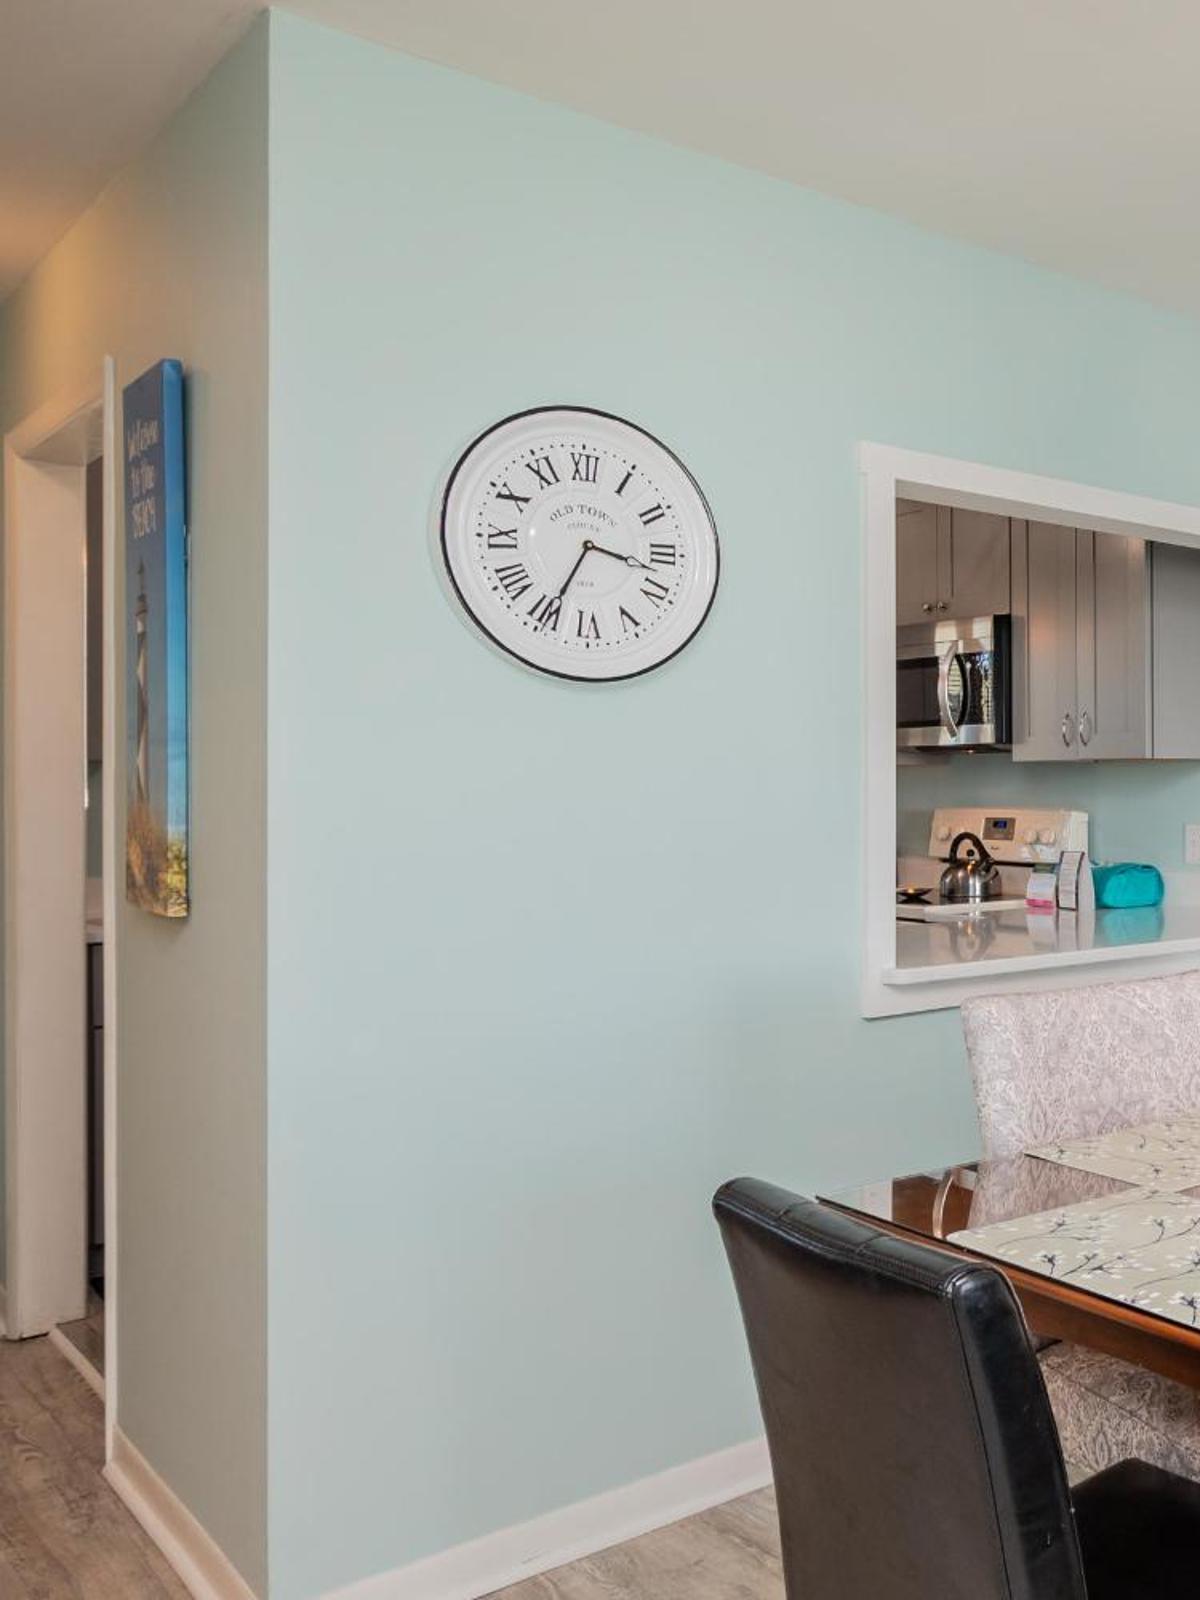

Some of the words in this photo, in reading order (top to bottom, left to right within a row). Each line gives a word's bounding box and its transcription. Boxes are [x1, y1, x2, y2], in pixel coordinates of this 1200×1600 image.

[525, 455, 561, 490] XI
[570, 452, 599, 483] XII
[614, 471, 632, 496] I
[495, 482, 533, 514] X
[549, 505, 573, 522] OLD
[639, 503, 665, 526] II
[487, 523, 517, 549] IX
[650, 543, 676, 566] III
[576, 609, 602, 639] VI
[619, 606, 640, 633] V
